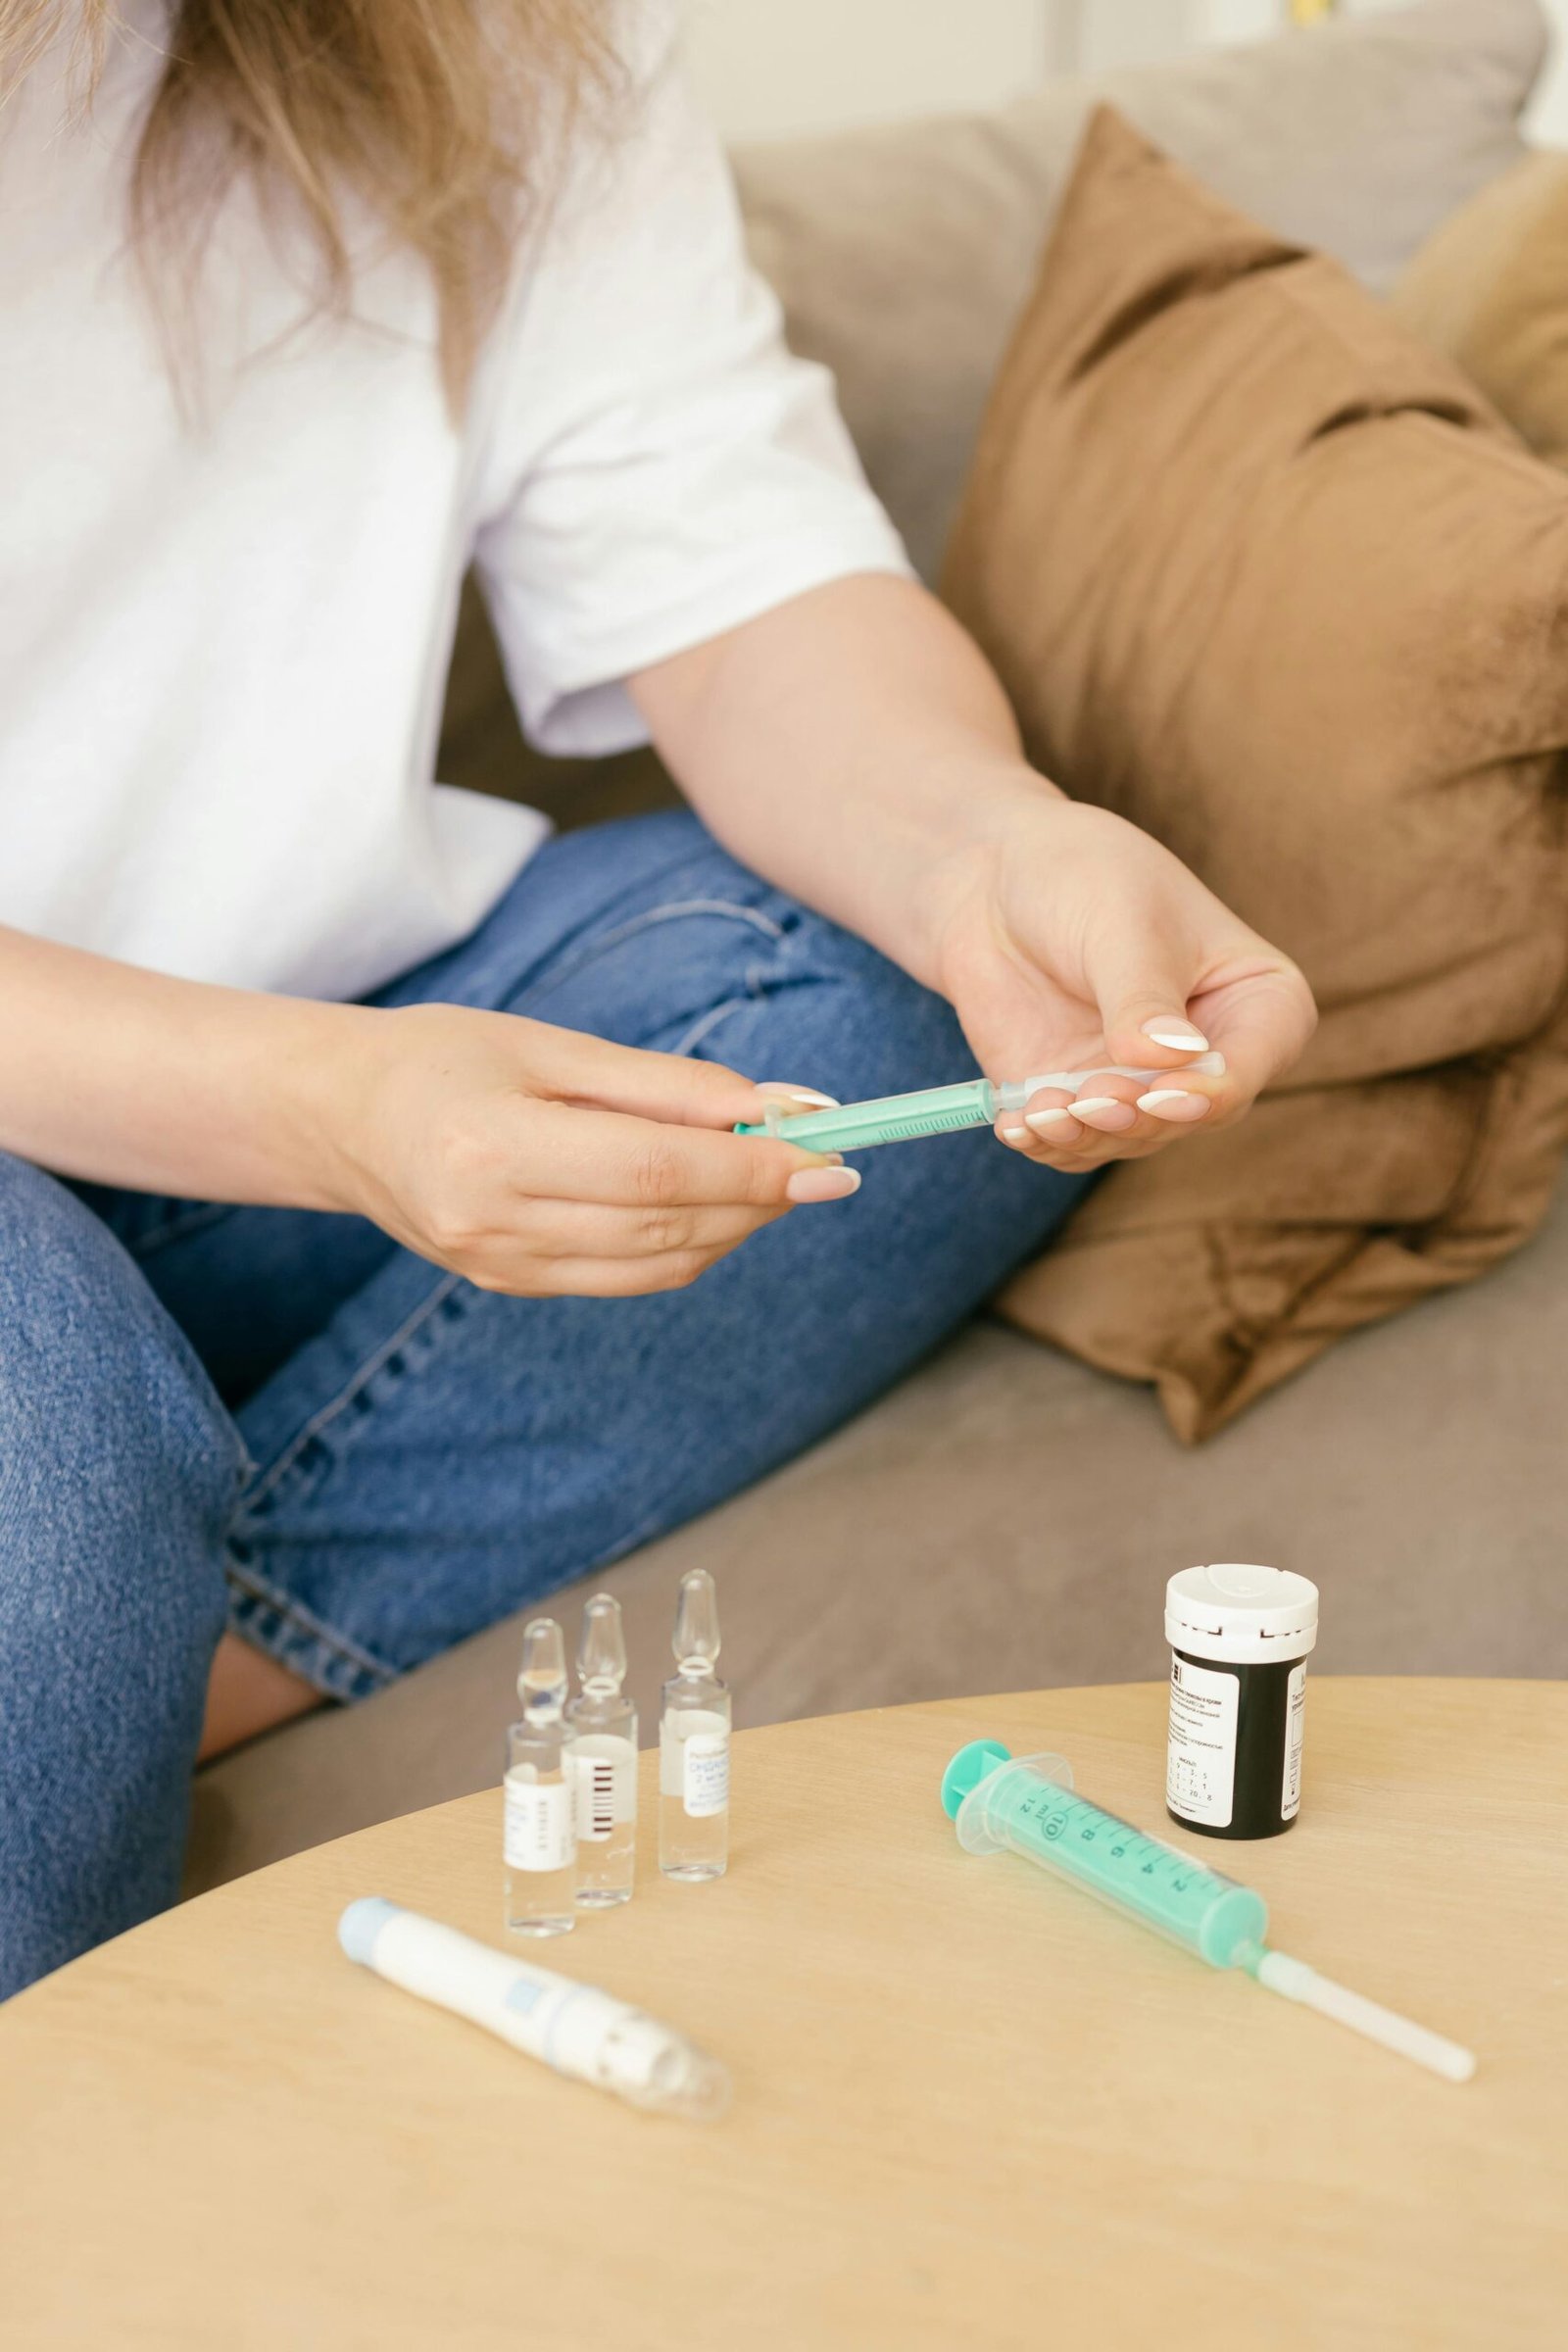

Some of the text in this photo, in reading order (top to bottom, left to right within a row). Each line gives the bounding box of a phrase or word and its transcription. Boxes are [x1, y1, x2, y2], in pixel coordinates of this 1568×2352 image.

[1020, 1798, 1036, 1813] 12
[1046, 1817, 1063, 1837] 10
[1081, 1829, 1096, 1840] 8
[1110, 1846, 1125, 1859] 6
[1141, 1863, 1153, 1874] 4
[1171, 1879, 1188, 1892] 2
